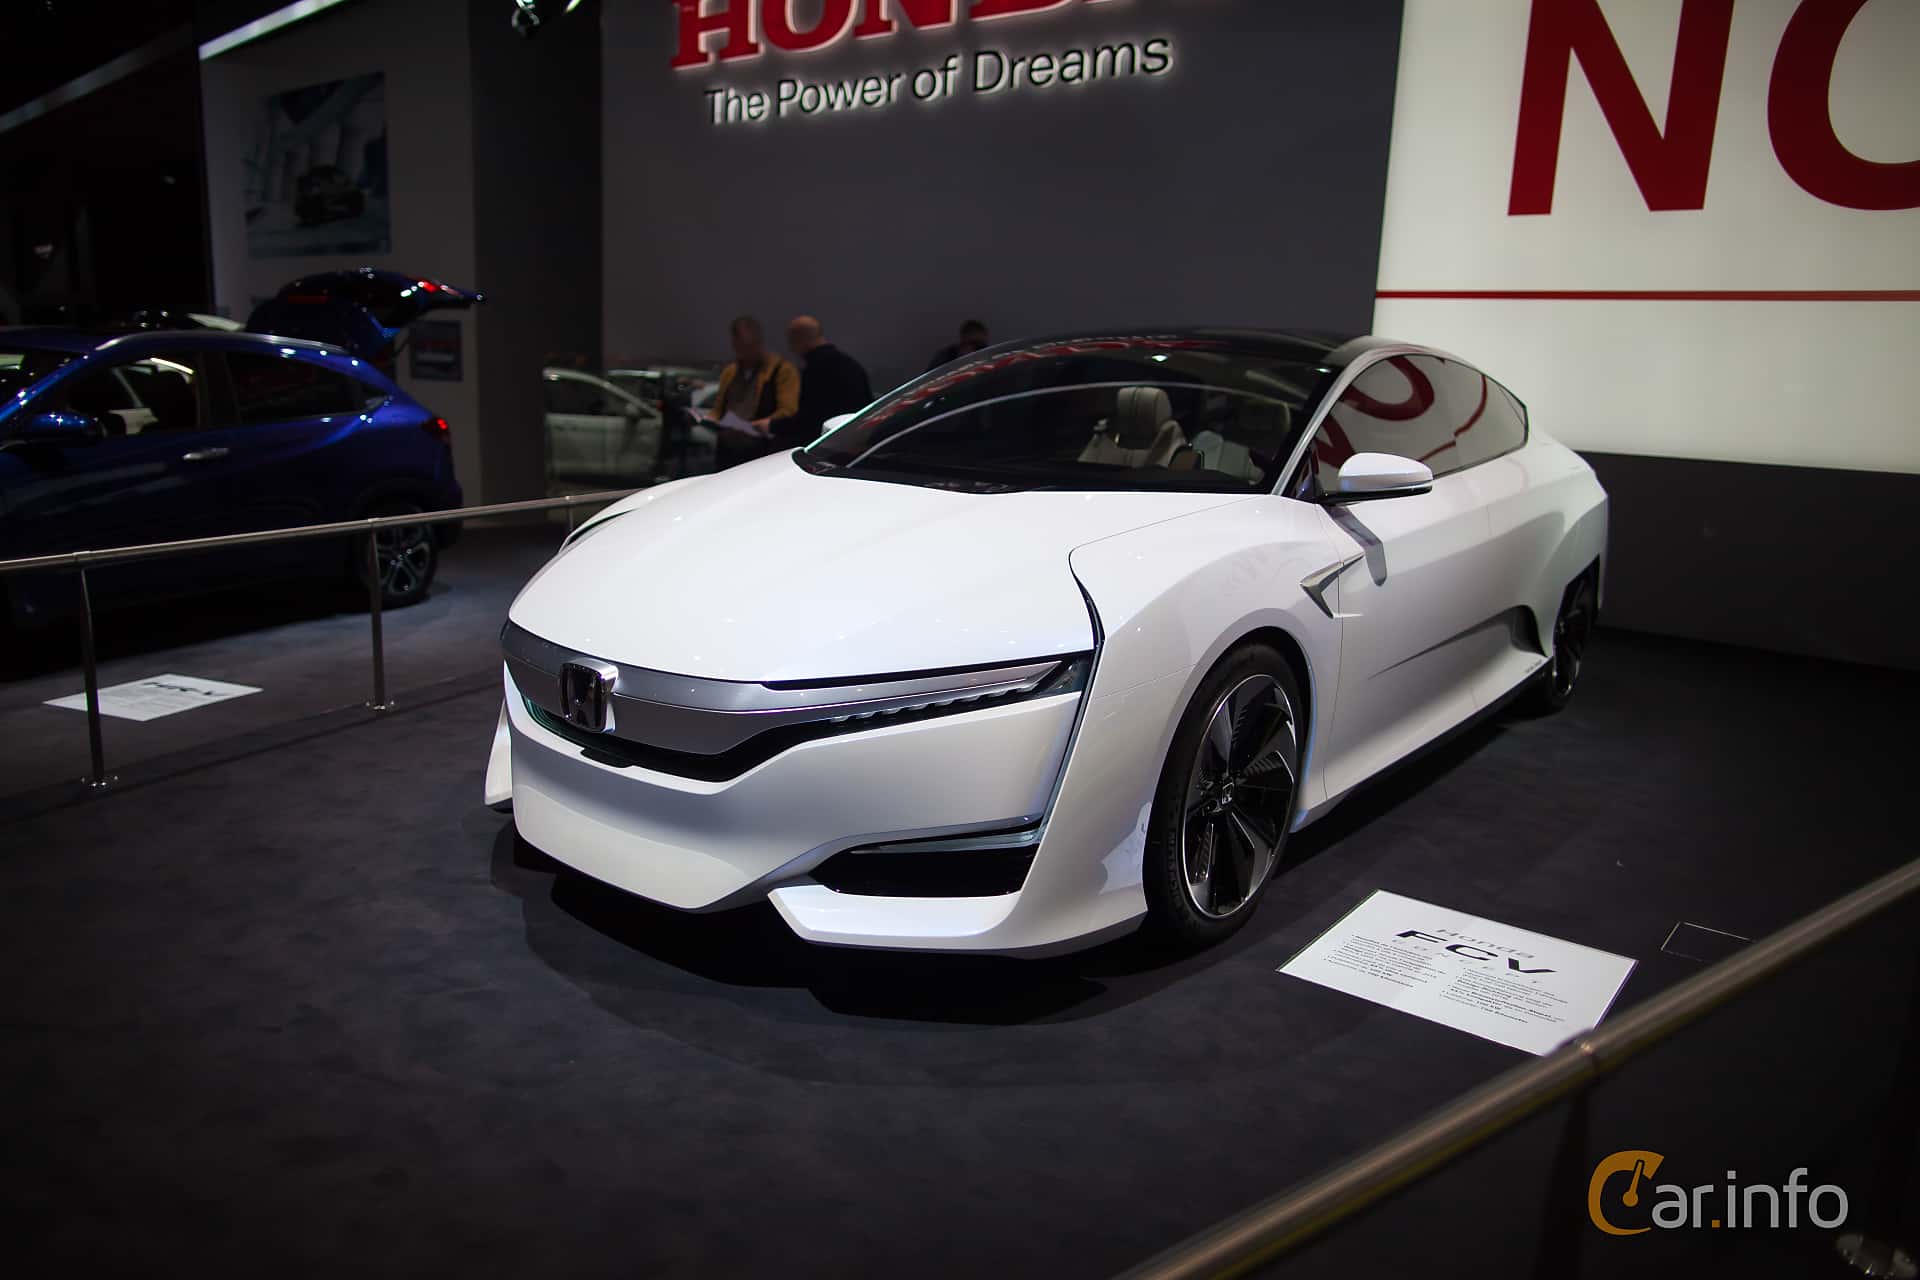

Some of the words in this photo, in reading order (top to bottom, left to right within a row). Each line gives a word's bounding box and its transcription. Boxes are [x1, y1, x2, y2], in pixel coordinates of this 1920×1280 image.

[704, 88, 771, 125] The
[777, 77, 906, 119] Power
[911, 54, 961, 101] of
[974, 37, 1173, 93] Dreams
[1396, 930, 1557, 974] FCV
